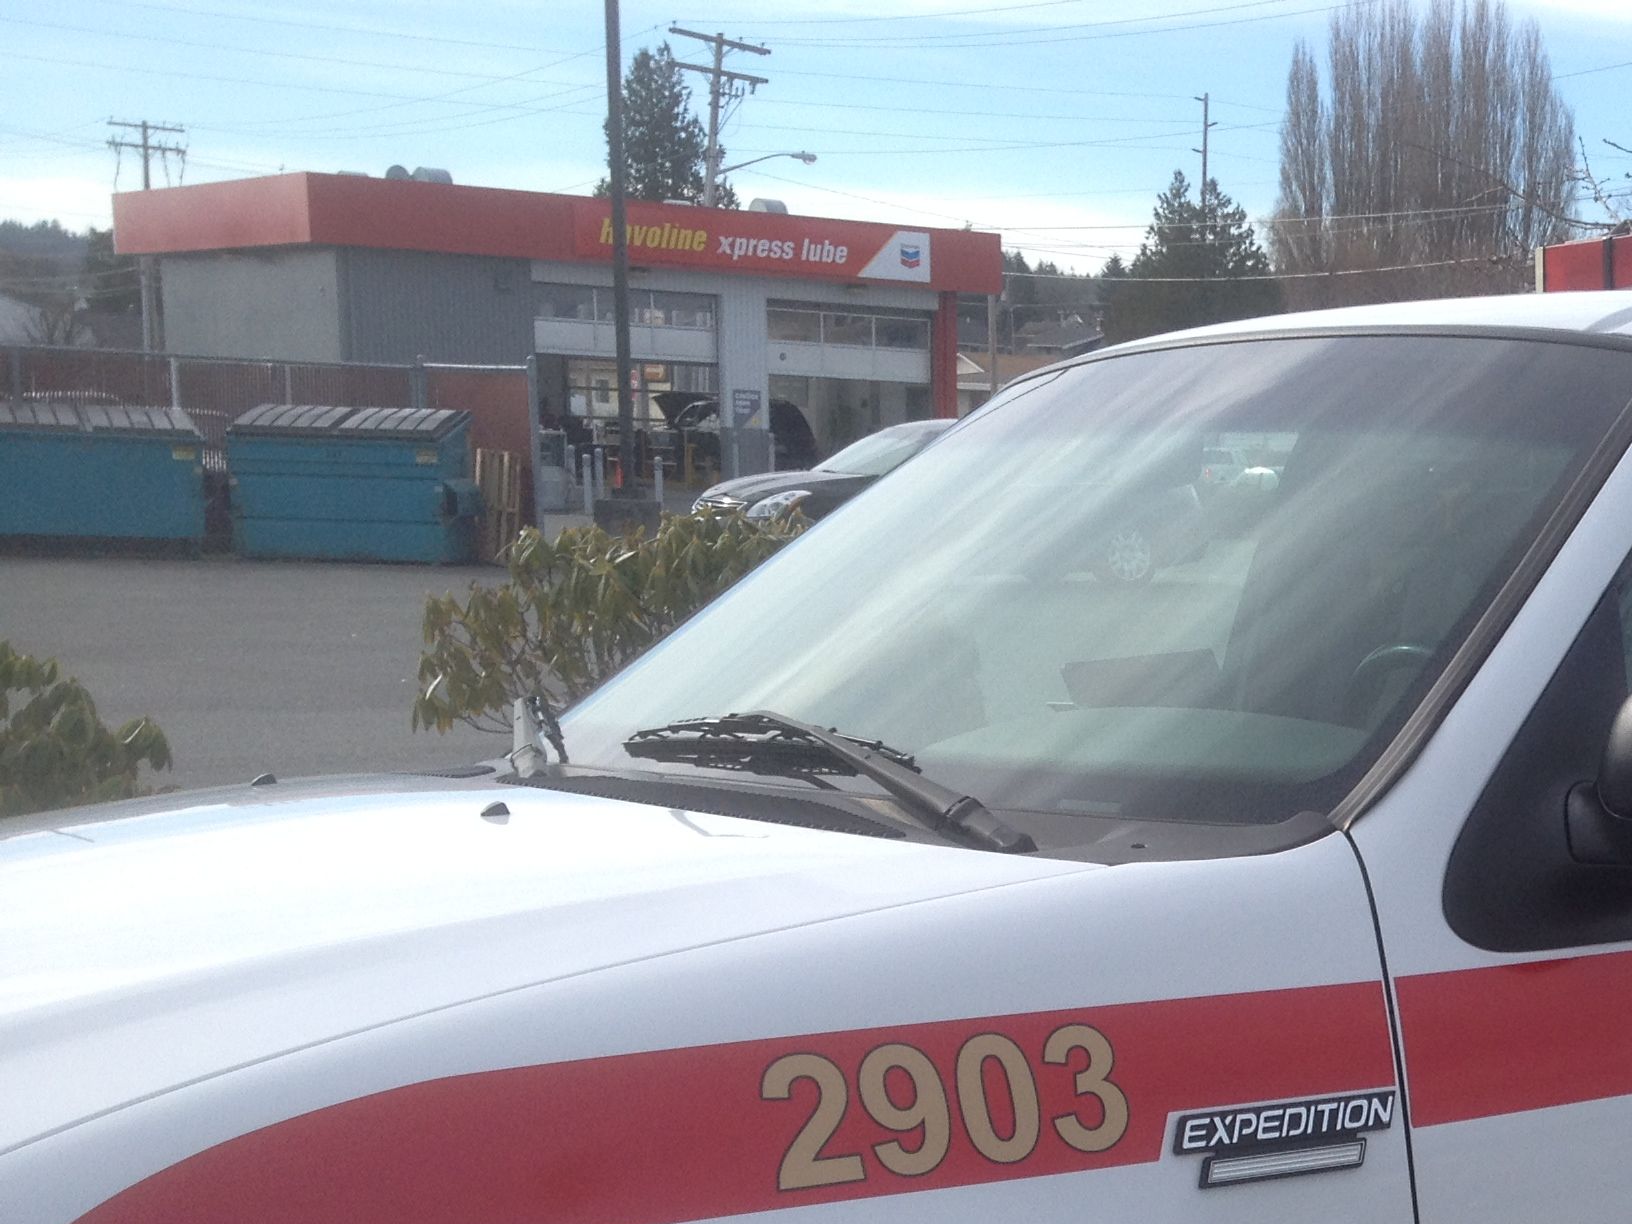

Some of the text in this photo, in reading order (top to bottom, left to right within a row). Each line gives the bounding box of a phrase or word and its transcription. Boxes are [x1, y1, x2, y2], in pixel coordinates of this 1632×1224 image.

[717, 236, 795, 260] xpress
[801, 238, 848, 264] lube
[760, 1023, 1130, 1192] 2903
[1180, 1095, 1394, 1150] EXPEDITION
